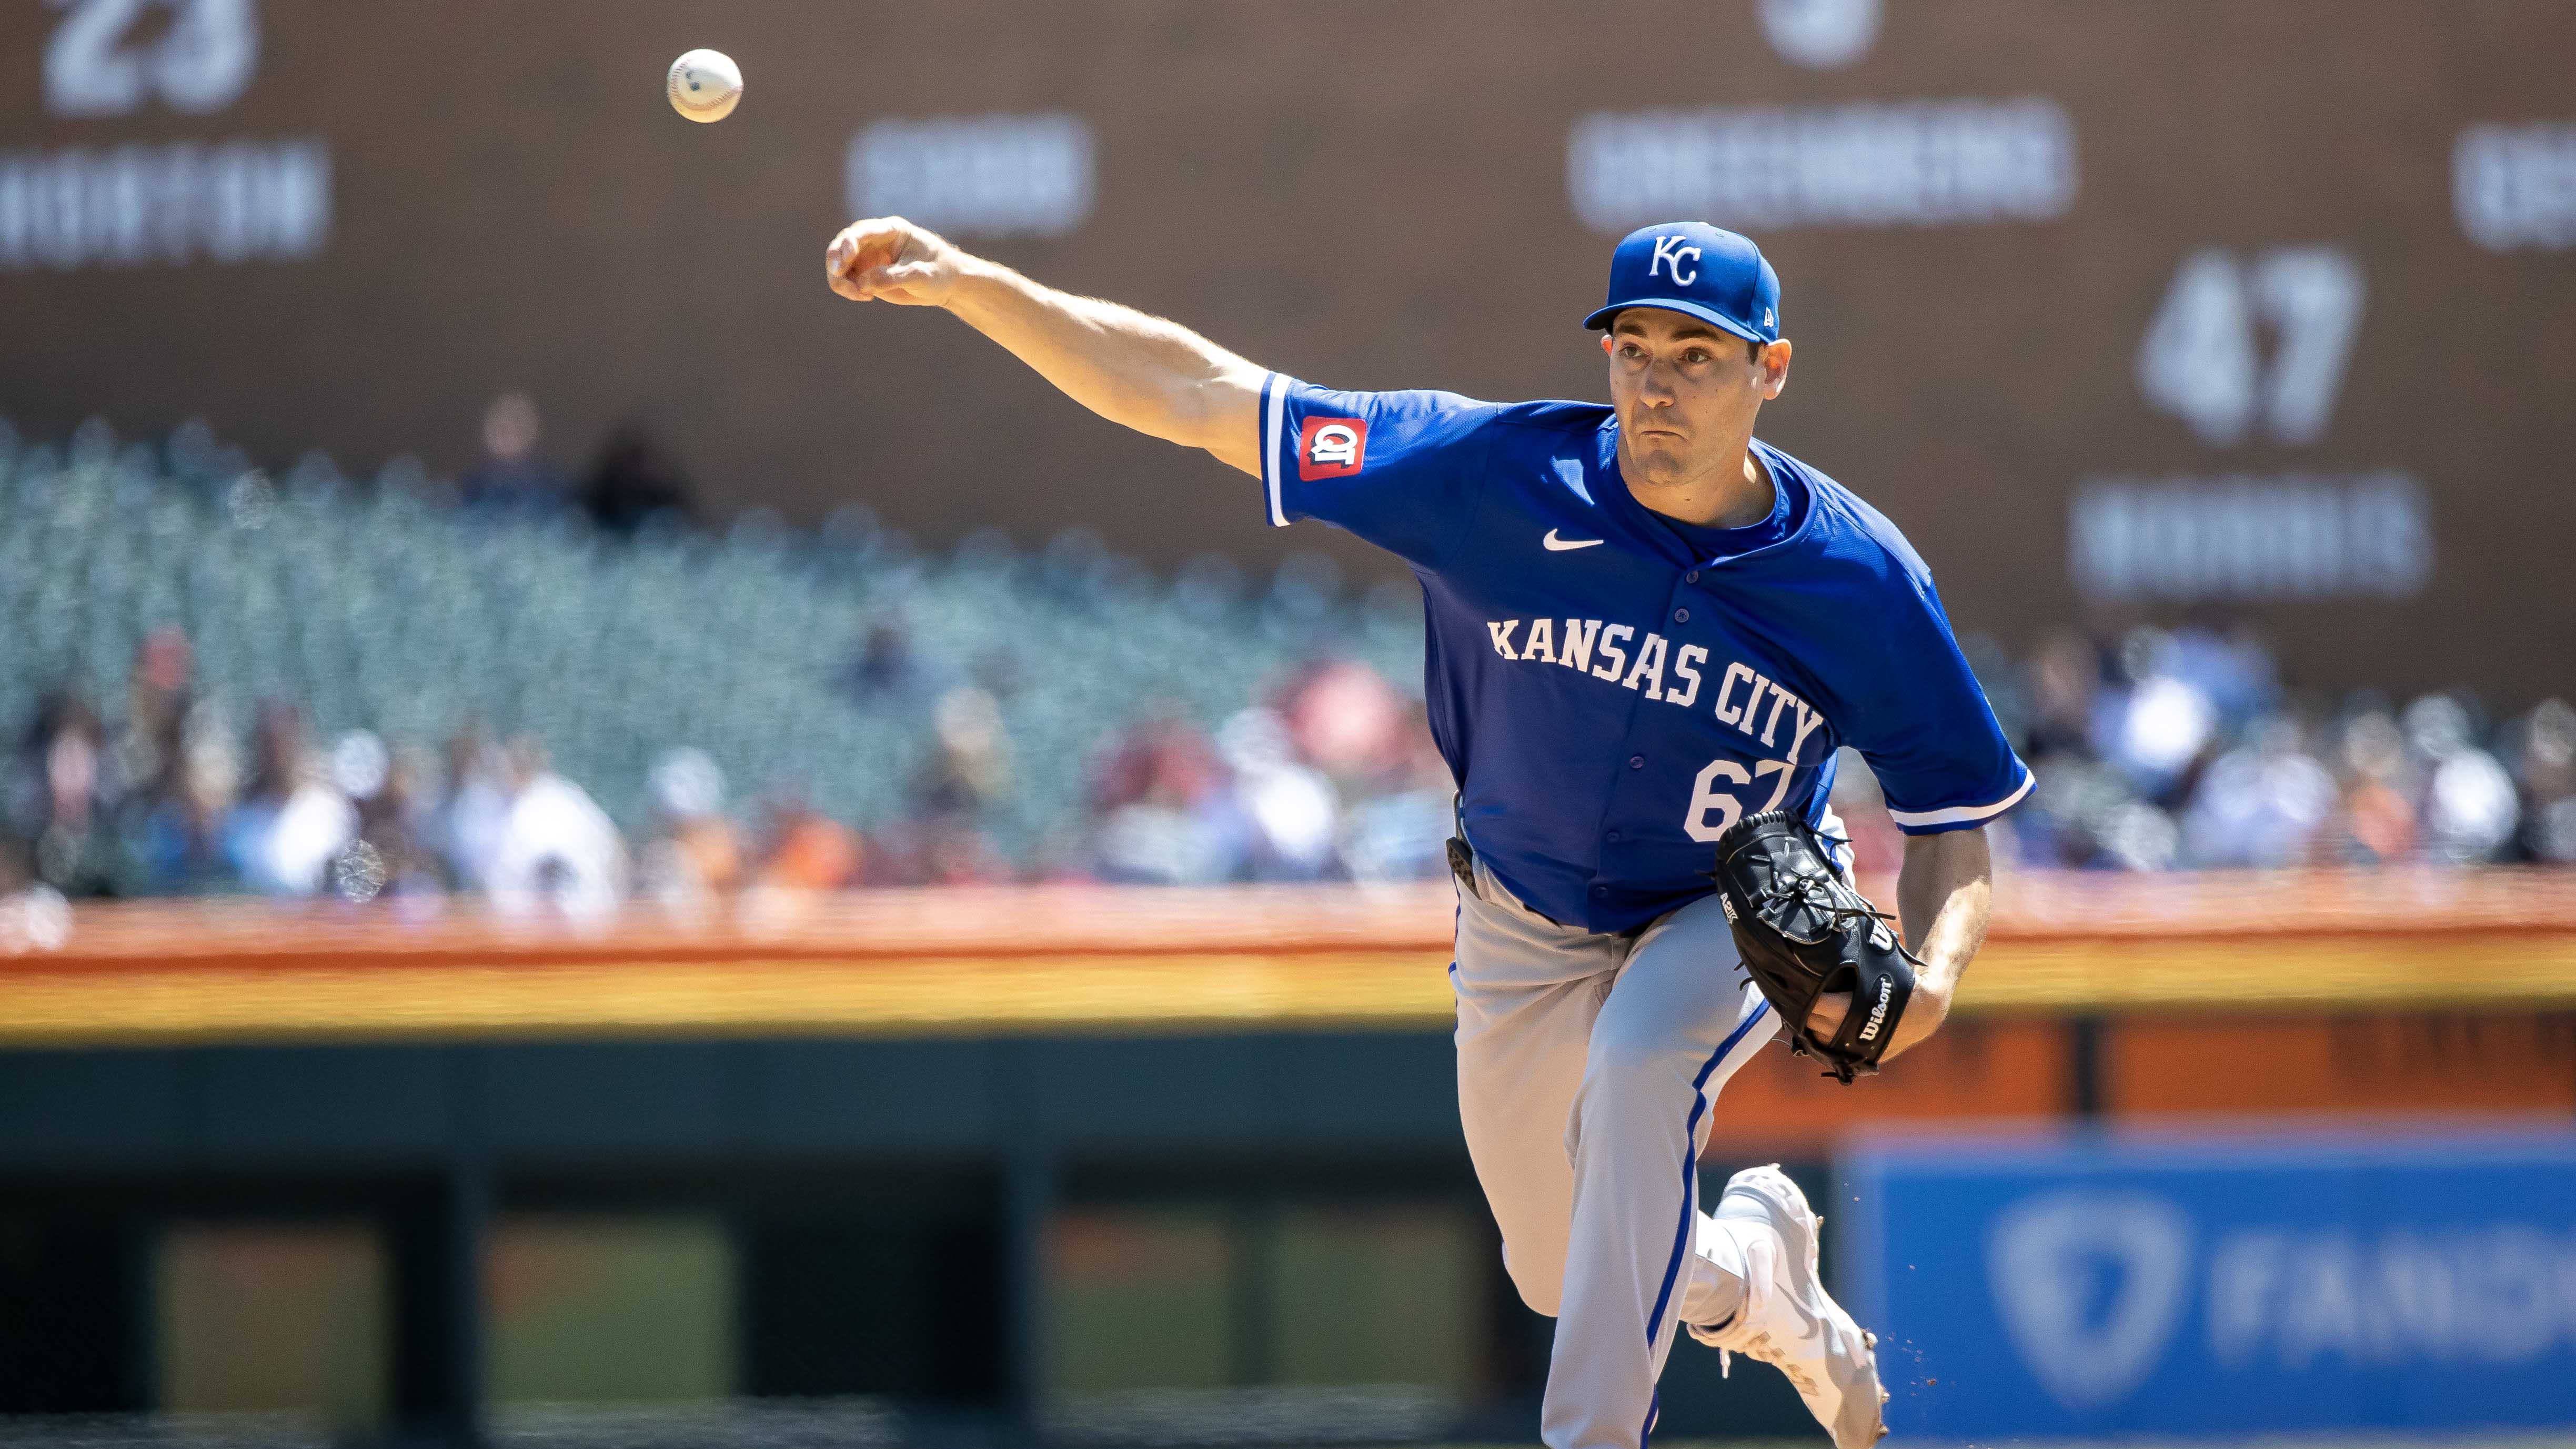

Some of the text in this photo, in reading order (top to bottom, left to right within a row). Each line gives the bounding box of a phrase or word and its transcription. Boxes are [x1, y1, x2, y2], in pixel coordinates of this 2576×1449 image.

[1649, 236, 1701, 287] KC
[2137, 247, 2366, 445] 47
[1487, 618, 1824, 766] KANSAS CITY
[1683, 759, 1796, 842] 67
[1858, 977, 1893, 1041] Wilson
